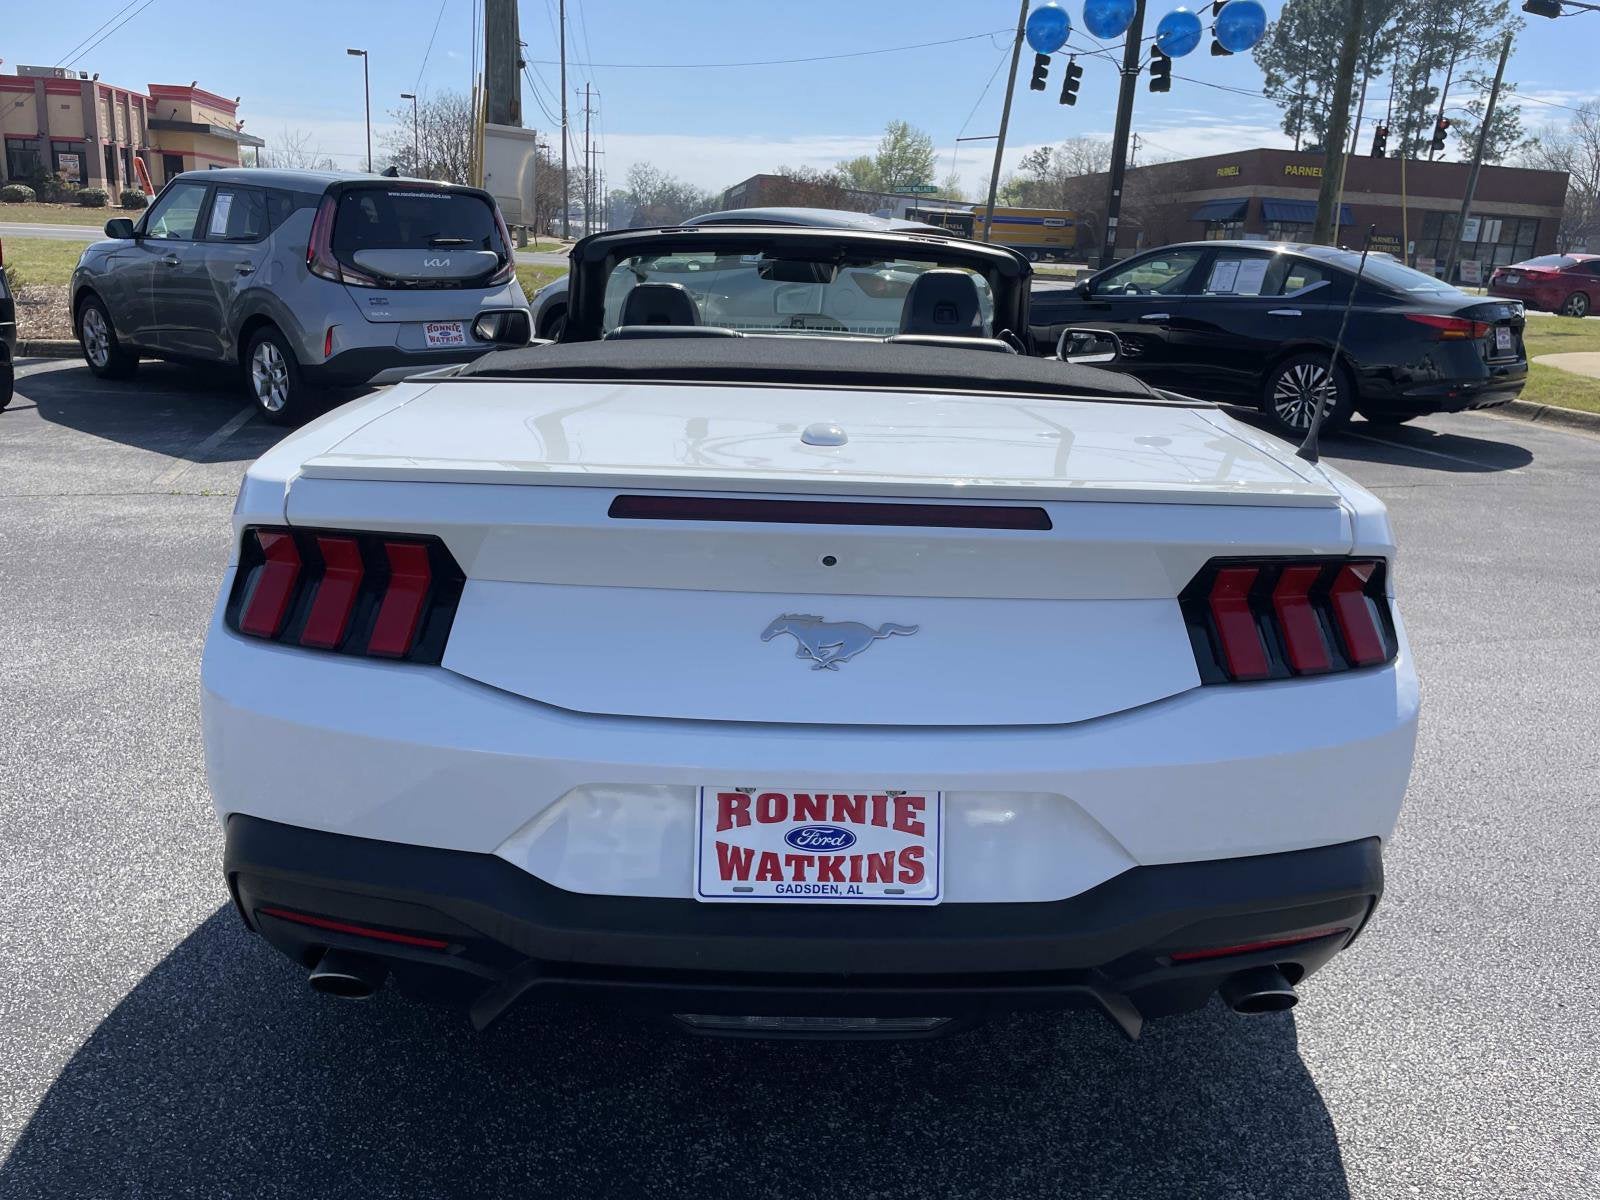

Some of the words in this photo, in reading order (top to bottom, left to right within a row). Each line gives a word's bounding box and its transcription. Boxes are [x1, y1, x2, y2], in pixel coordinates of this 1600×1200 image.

[1284, 165, 1323, 177] PARNEL
[426, 324, 461, 333] RONNIE
[428, 335, 463, 344] WATKINS
[716, 792, 926, 838] RONNIE
[796, 828, 846, 848] Ford
[715, 840, 925, 885] WATKINS
[775, 884, 842, 897] GADSDEN,
[847, 885, 864, 895] AL
